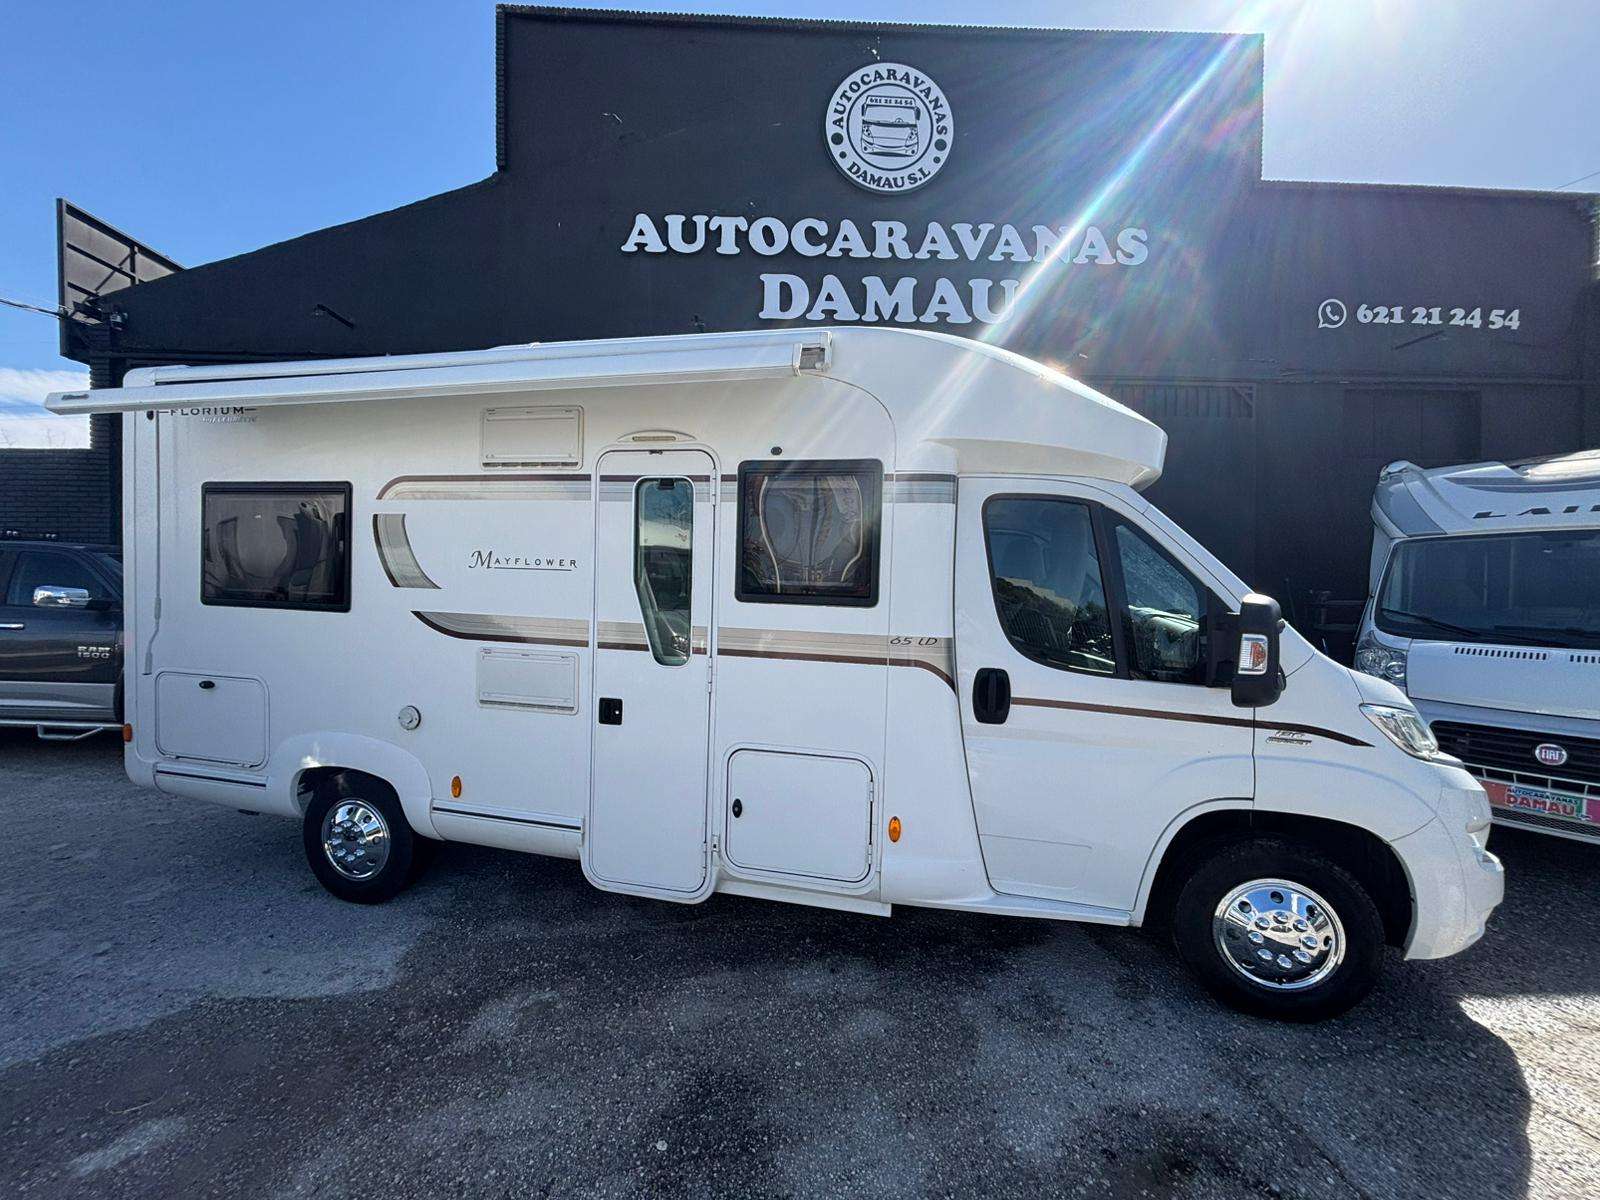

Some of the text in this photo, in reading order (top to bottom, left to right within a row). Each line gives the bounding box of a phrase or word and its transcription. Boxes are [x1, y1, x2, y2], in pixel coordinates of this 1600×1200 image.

[832, 68, 948, 136] AUTOCARAVANAS
[847, 161, 905, 188] DAMAU
[621, 213, 1150, 266] AUTOCARAVANAS
[758, 273, 1020, 324] DAMAU
[1356, 303, 1520, 330] 621 21 24 54
[890, 636, 912, 645] 65
[1541, 749, 1560, 760] FIAT
[1505, 793, 1575, 816] DAMAU
